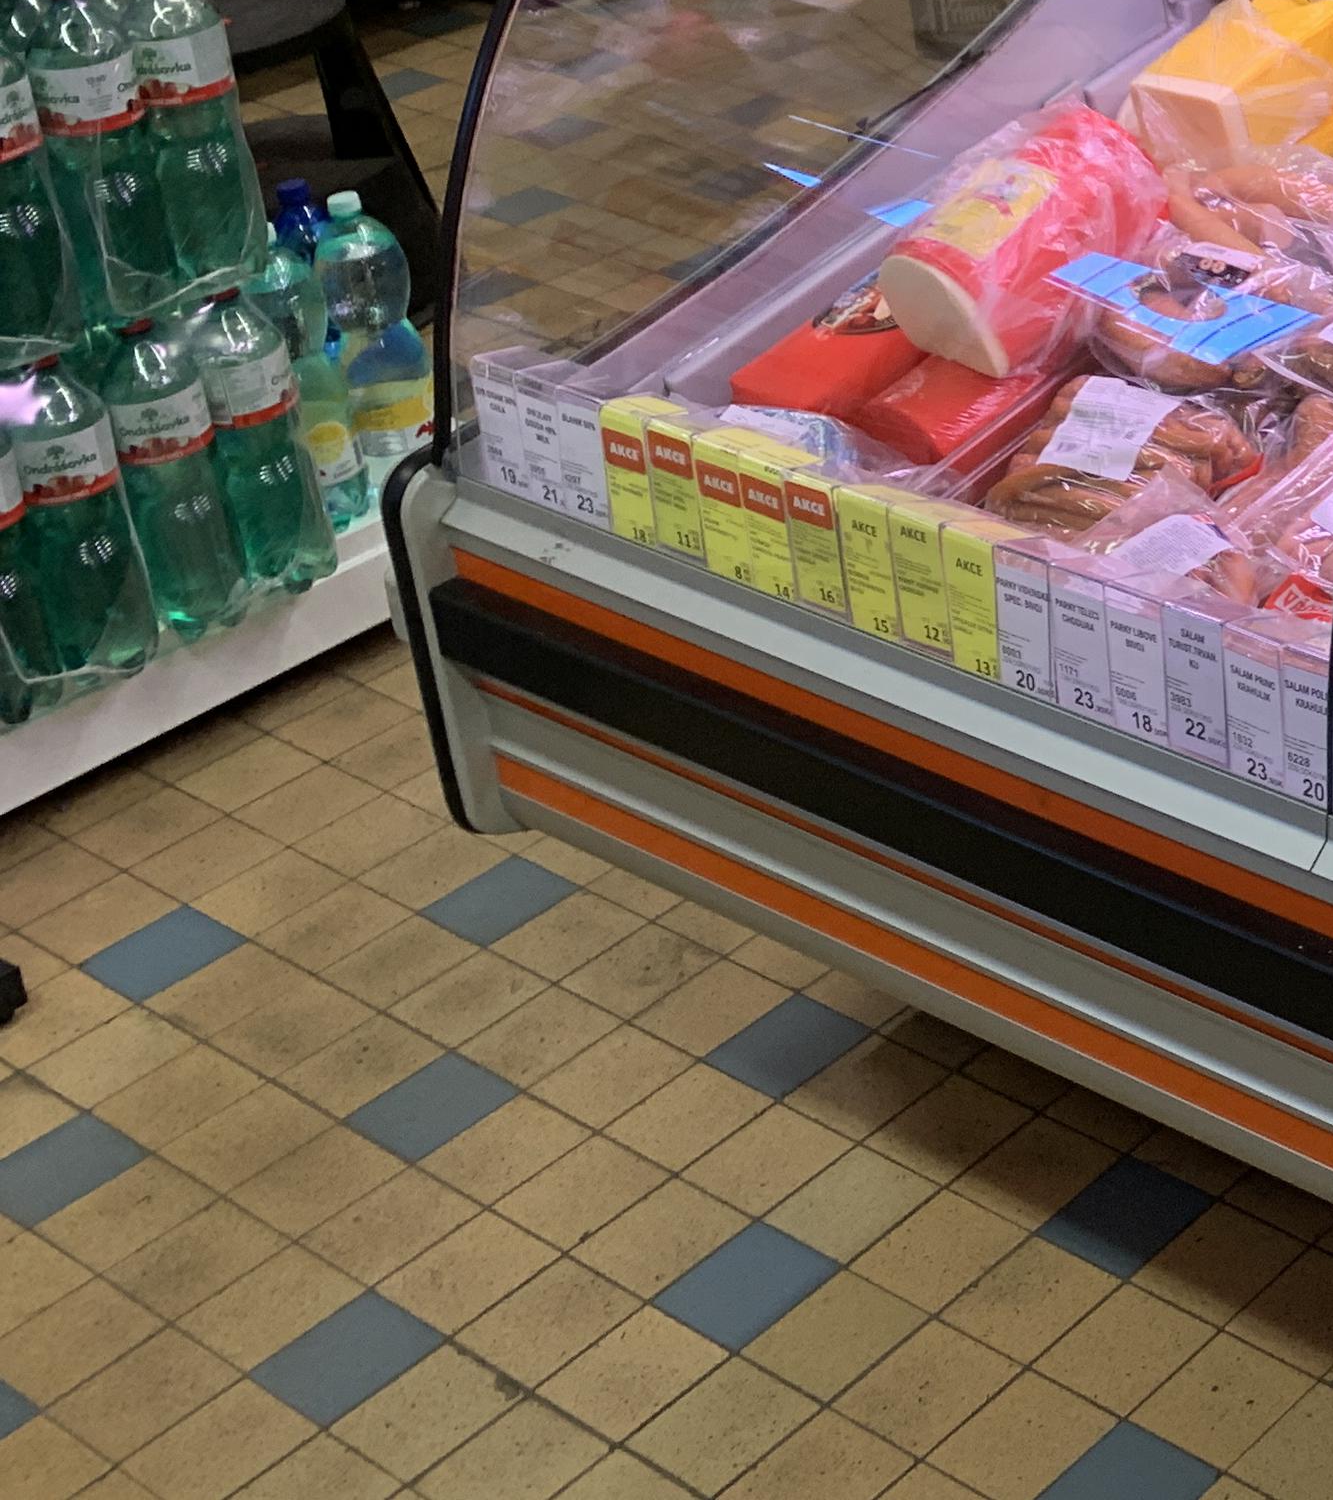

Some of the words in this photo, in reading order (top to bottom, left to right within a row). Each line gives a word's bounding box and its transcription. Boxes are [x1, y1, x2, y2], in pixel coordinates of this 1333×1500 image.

[608, 441, 640, 464] AKCE
[955, 555, 984, 578] AKCE
[1015, 669, 1036, 692] 20
[1073, 687, 1095, 710] 23
[1132, 711, 1153, 734] 18
[1185, 717, 1206, 741] 22
[1247, 757, 1268, 781] 23
